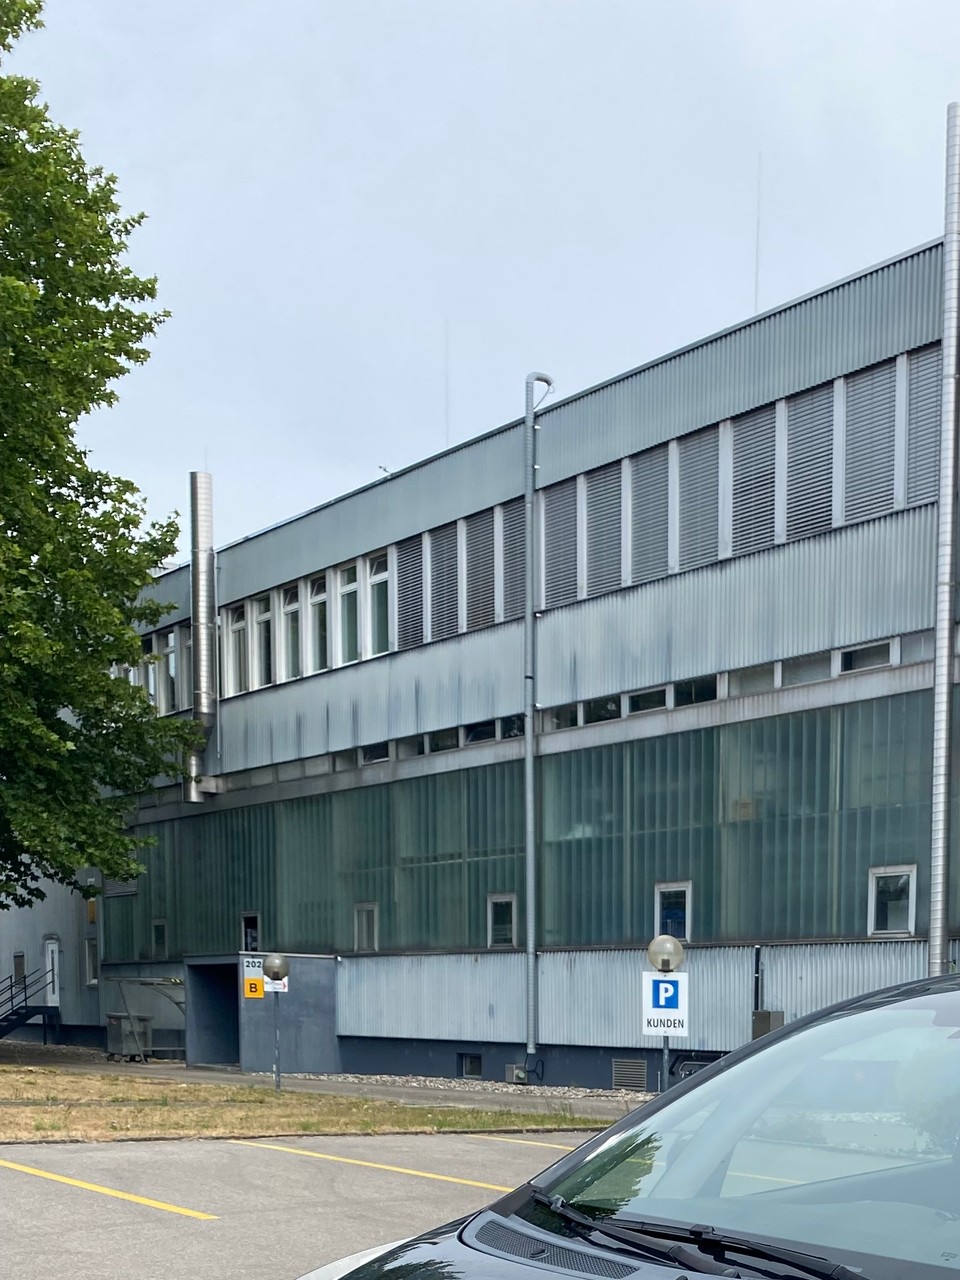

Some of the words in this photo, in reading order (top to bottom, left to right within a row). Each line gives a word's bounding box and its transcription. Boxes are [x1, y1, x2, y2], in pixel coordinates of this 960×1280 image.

[245, 960, 262, 968] 202
[249, 983, 258, 993] B
[659, 982, 674, 1006] P
[646, 1018, 684, 1029] KUNDEN
